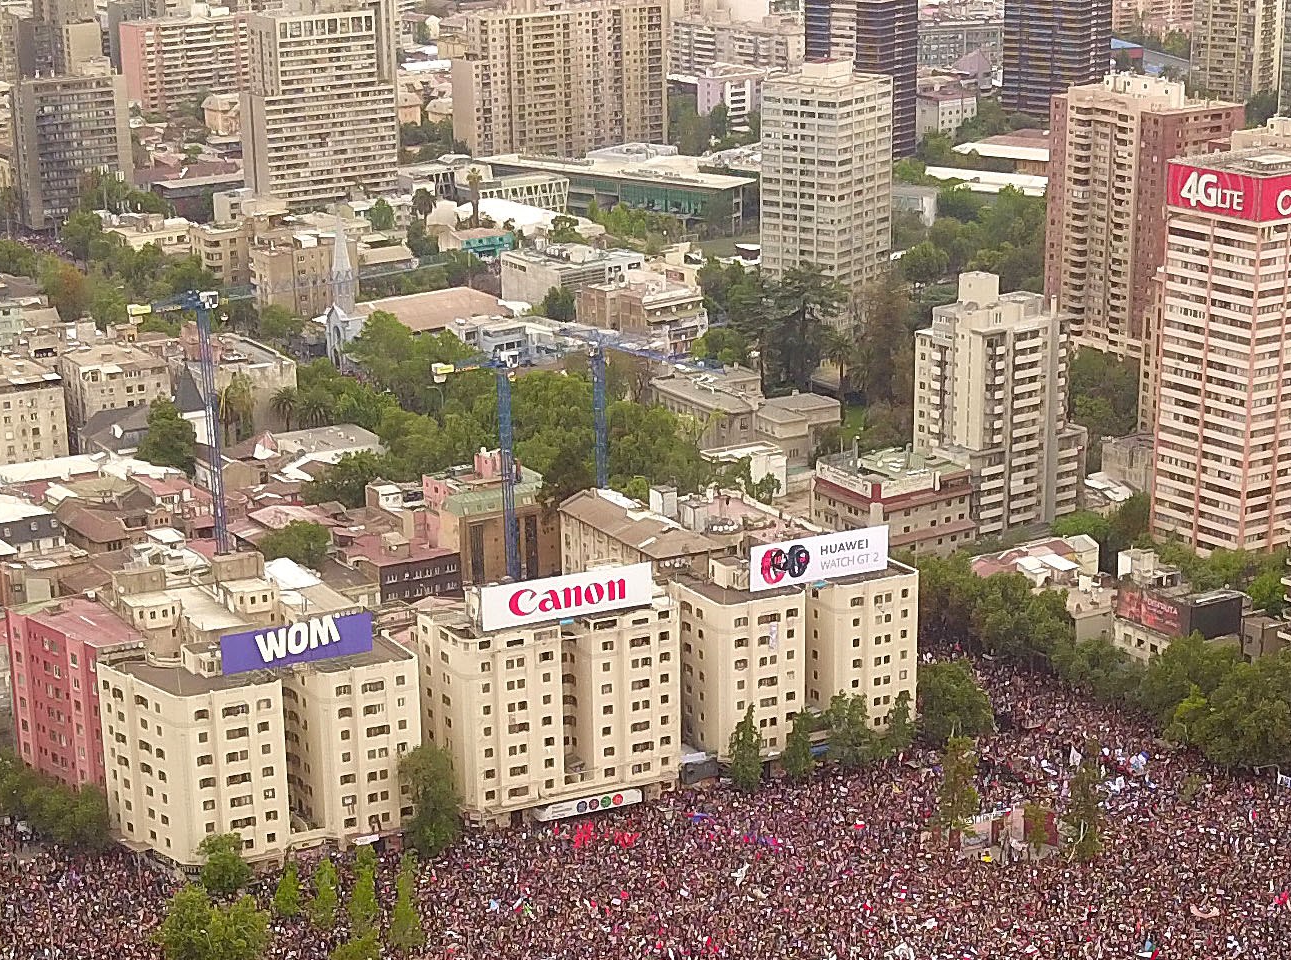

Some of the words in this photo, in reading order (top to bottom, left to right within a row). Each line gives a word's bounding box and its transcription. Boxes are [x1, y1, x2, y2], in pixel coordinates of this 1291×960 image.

[820, 538, 869, 555] HUAWEI
[820, 555, 855, 570] WATCH
[857, 553, 870, 564] GT
[873, 552, 879, 562] 2
[508, 578, 626, 617] Canon
[254, 614, 341, 663] WOM
